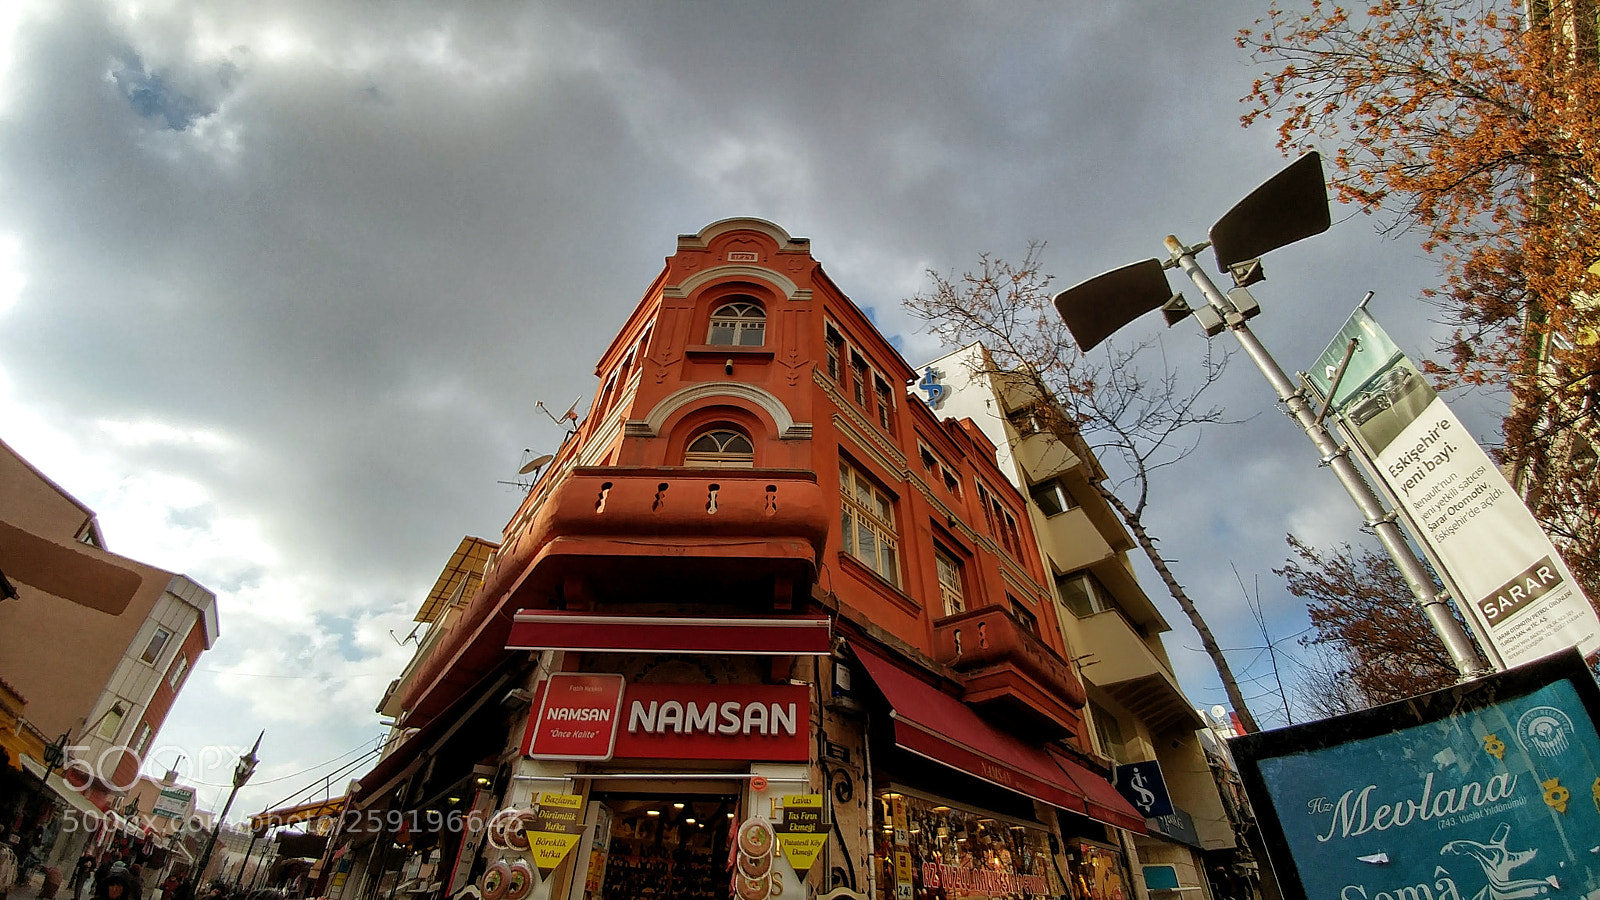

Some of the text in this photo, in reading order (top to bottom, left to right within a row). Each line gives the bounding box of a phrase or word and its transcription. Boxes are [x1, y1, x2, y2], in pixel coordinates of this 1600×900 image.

[1388, 419, 1451, 478] Eskişehir'e
[1400, 441, 1458, 498] yeni bayi.
[1412, 472, 1458, 511] Renault'nun
[1421, 465, 1487, 523] yeni yetkili satıcısı
[1447, 481, 1491, 516] Otomotiv,
[1483, 564, 1555, 619] SARAR
[547, 707, 611, 721] NAMSAN
[628, 700, 797, 736] NAMSAN
[538, 810, 577, 821] Dürümlük
[544, 794, 577, 805] Bazlama
[1316, 772, 1519, 843] Mevlana
[544, 821, 566, 831] Yufka
[1458, 810, 1483, 825] Vuslat
[535, 836, 567, 847] Böreklik
[539, 848, 561, 859] Yufka
